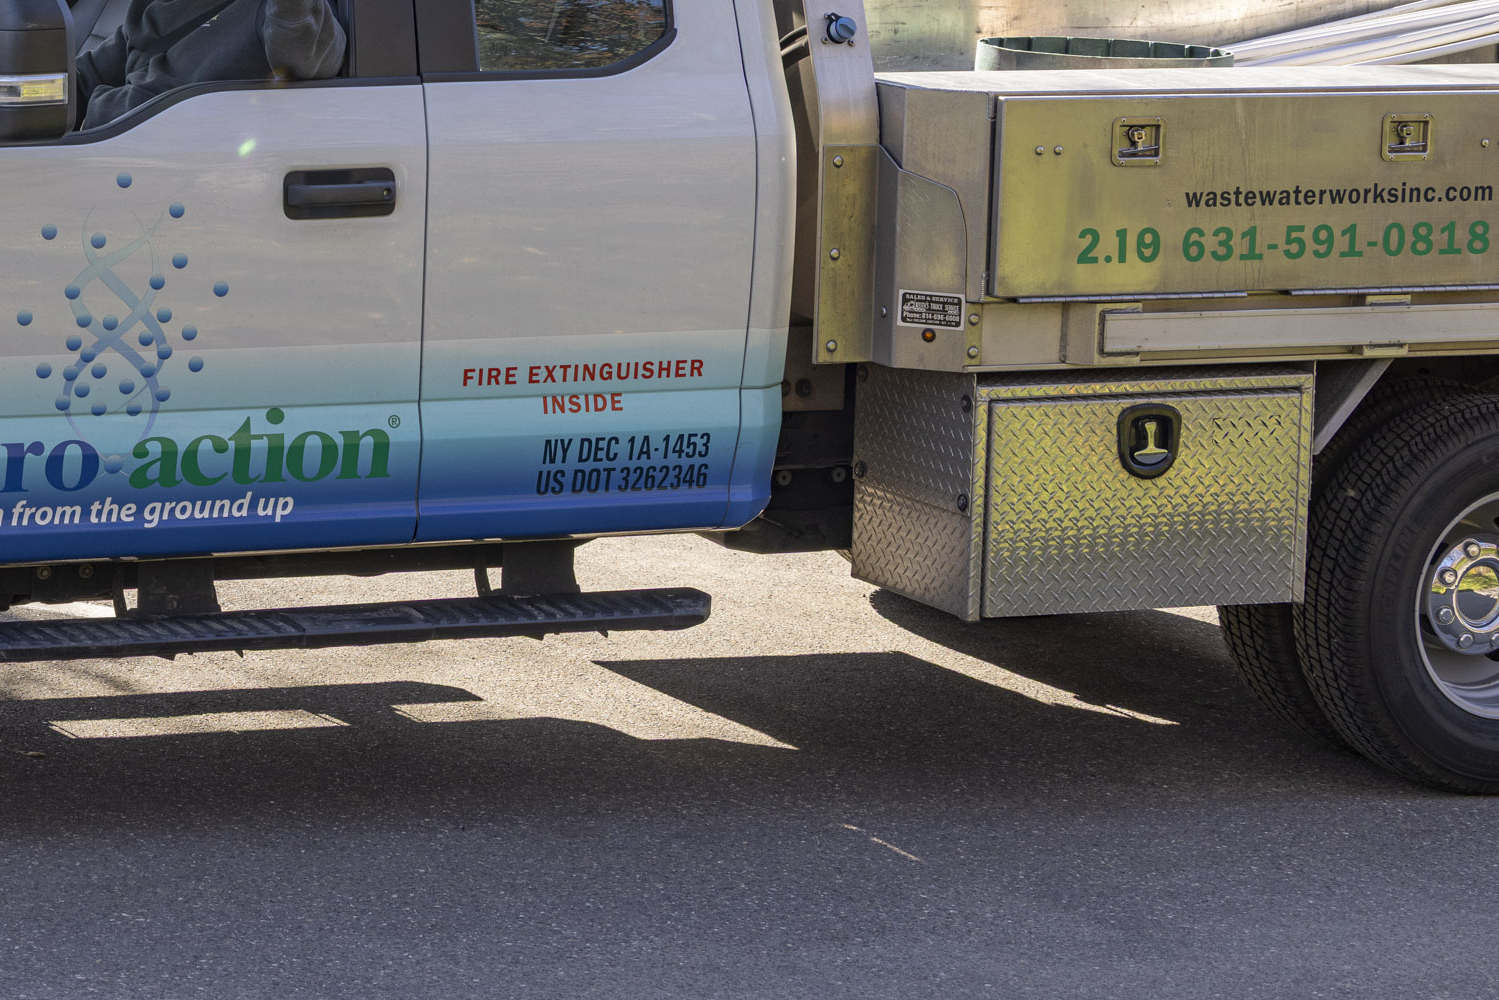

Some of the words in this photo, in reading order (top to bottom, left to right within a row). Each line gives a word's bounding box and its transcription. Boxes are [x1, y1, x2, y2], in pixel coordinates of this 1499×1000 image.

[1185, 182, 1493, 208] wastewaterworksinc.com
[1182, 220, 1490, 263] 631-591-0818
[931, 296, 959, 304] SERVICE
[462, 366, 518, 387] FIRE
[528, 359, 704, 385] EXTINGUISHER
[542, 392, 624, 415] INSIDE
[542, 437, 574, 465] NY
[577, 435, 620, 463] DEC
[627, 432, 711, 461] 1A-1453
[536, 469, 566, 496] US
[571, 467, 616, 494] DOT
[617, 463, 709, 492] 3262346
[11, 499, 83, 527] from
[89, 497, 136, 525] the
[143, 491, 253, 529] ground
[257, 496, 295, 523] up
